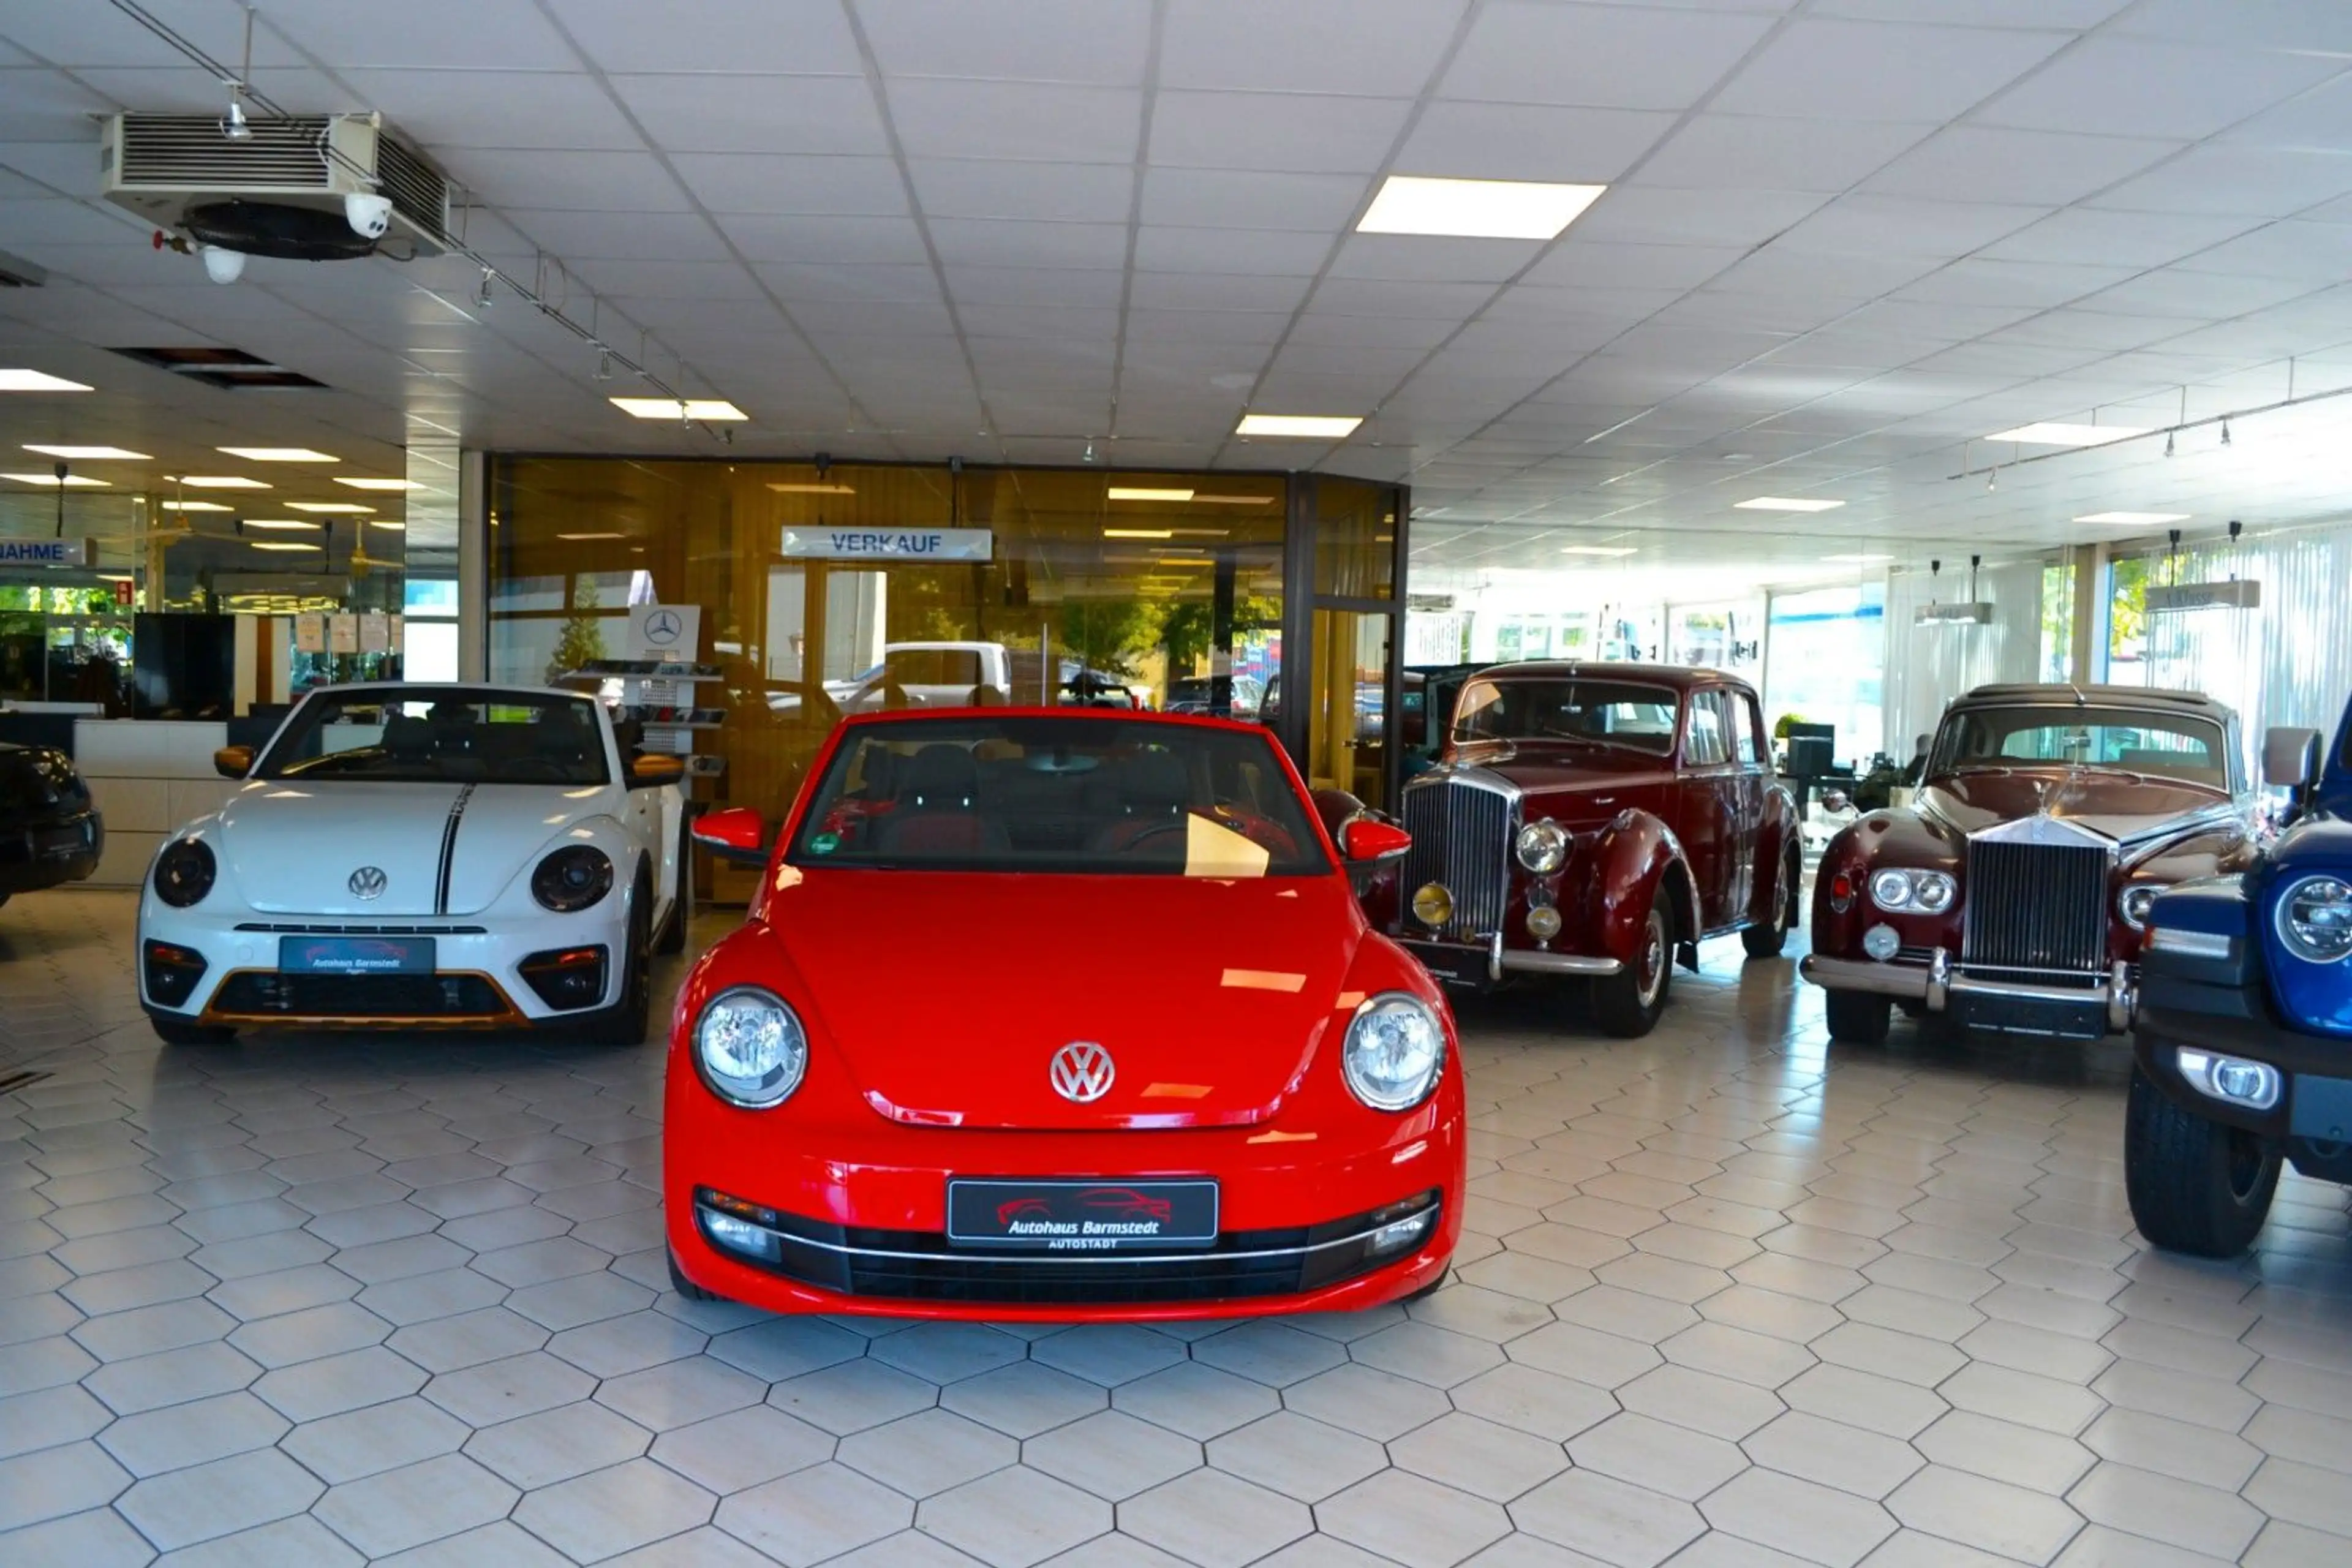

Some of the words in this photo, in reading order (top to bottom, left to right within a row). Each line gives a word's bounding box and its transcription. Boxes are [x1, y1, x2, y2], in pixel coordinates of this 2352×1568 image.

[831, 532, 942, 553] VERKAUF
[1050, 1042, 1115, 1101] VW
[1009, 1221, 1078, 1234] Autohaus
[1082, 1221, 1159, 1235] Barmstedt
[1048, 1238, 1118, 1249] AUTOSTADT
